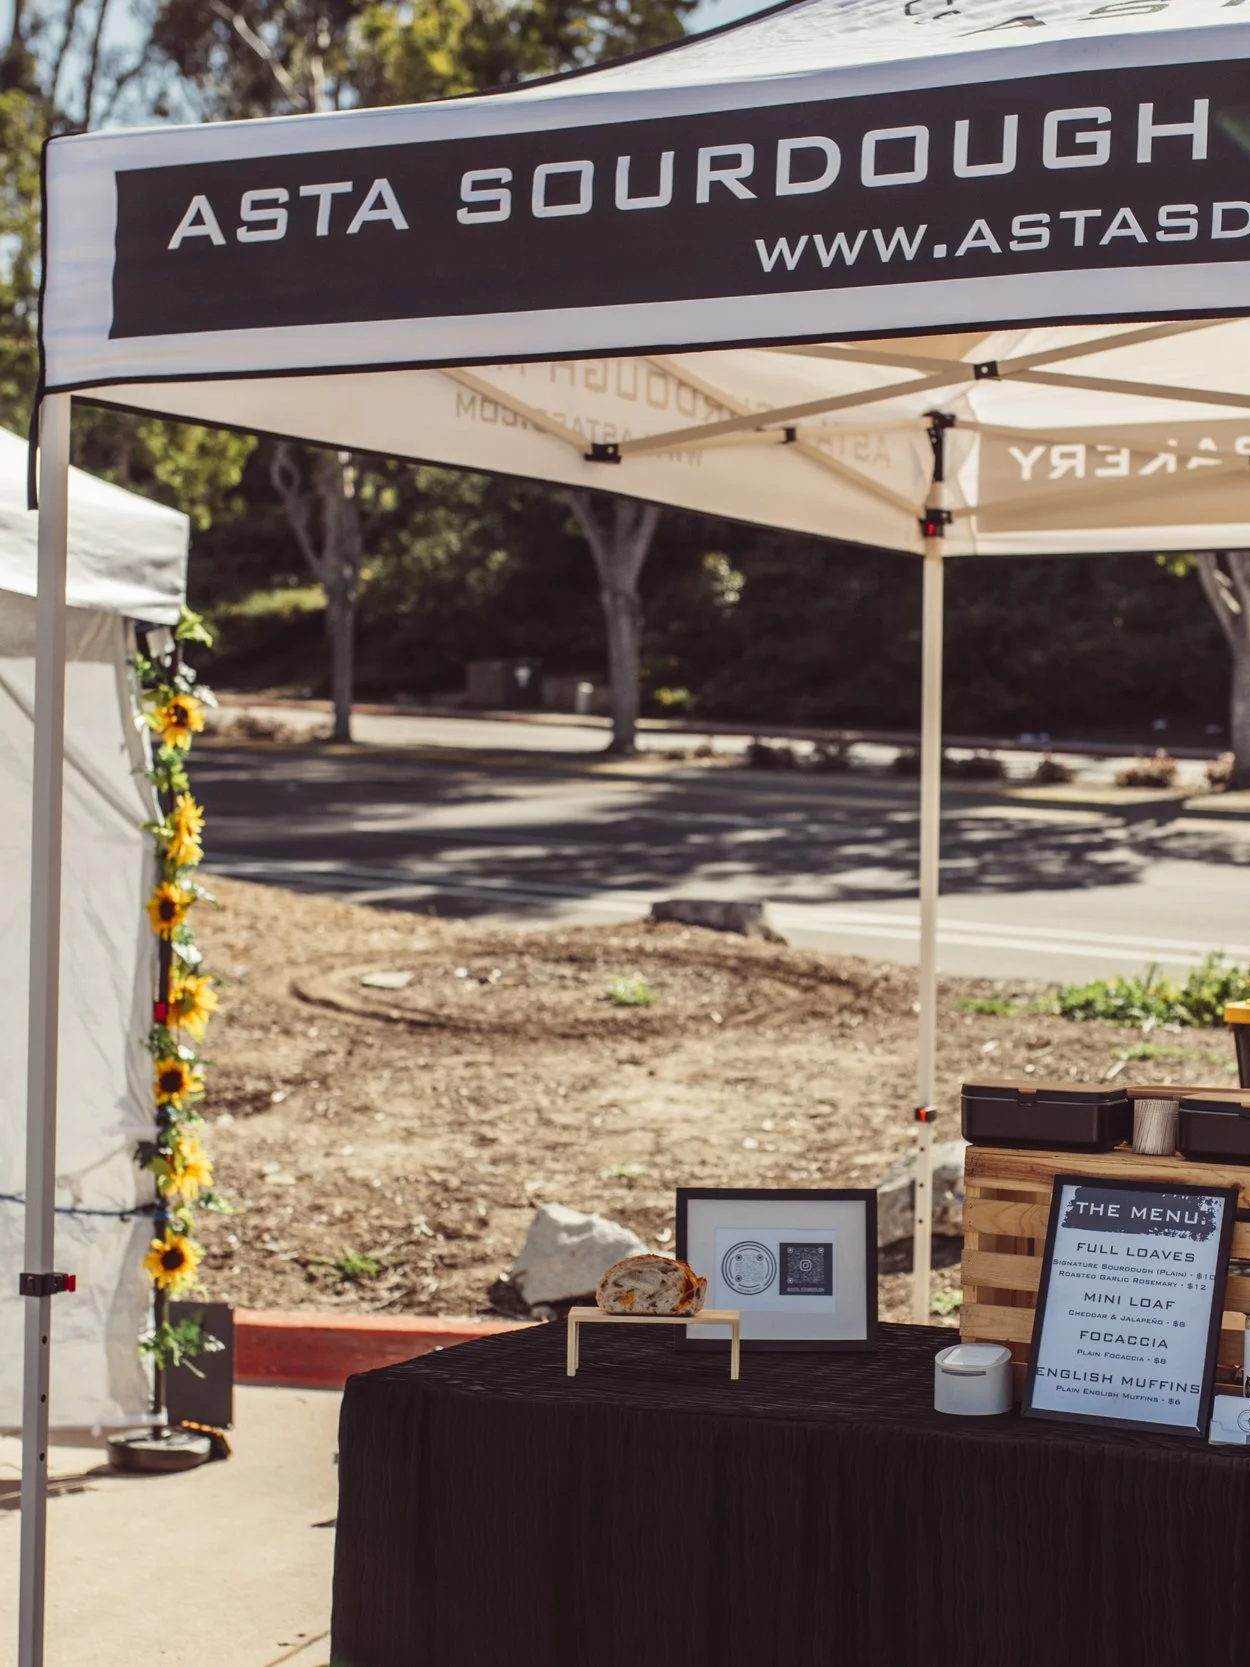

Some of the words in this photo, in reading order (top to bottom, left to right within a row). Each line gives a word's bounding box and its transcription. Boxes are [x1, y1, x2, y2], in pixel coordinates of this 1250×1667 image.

[167, 178, 409, 250] ASTA
[456, 99, 1209, 225] SOURDOUGH
[1076, 1201, 1121, 1218] THE
[1077, 1242, 1119, 1256] FULL
[1126, 1247, 1195, 1263] LOAVES
[1187, 1283, 1207, 1291] $12
[1084, 1292, 1121, 1305] MINI
[1129, 1297, 1175, 1310] LOAF
[1173, 1320, 1186, 1328] $8
[1079, 1330, 1168, 1349] FOCACCIA
[1154, 1357, 1167, 1365] $8
[1036, 1367, 1113, 1384] ENGLISH
[1121, 1376, 1200, 1394] MUFFINS
[1168, 1397, 1181, 1406] $6
